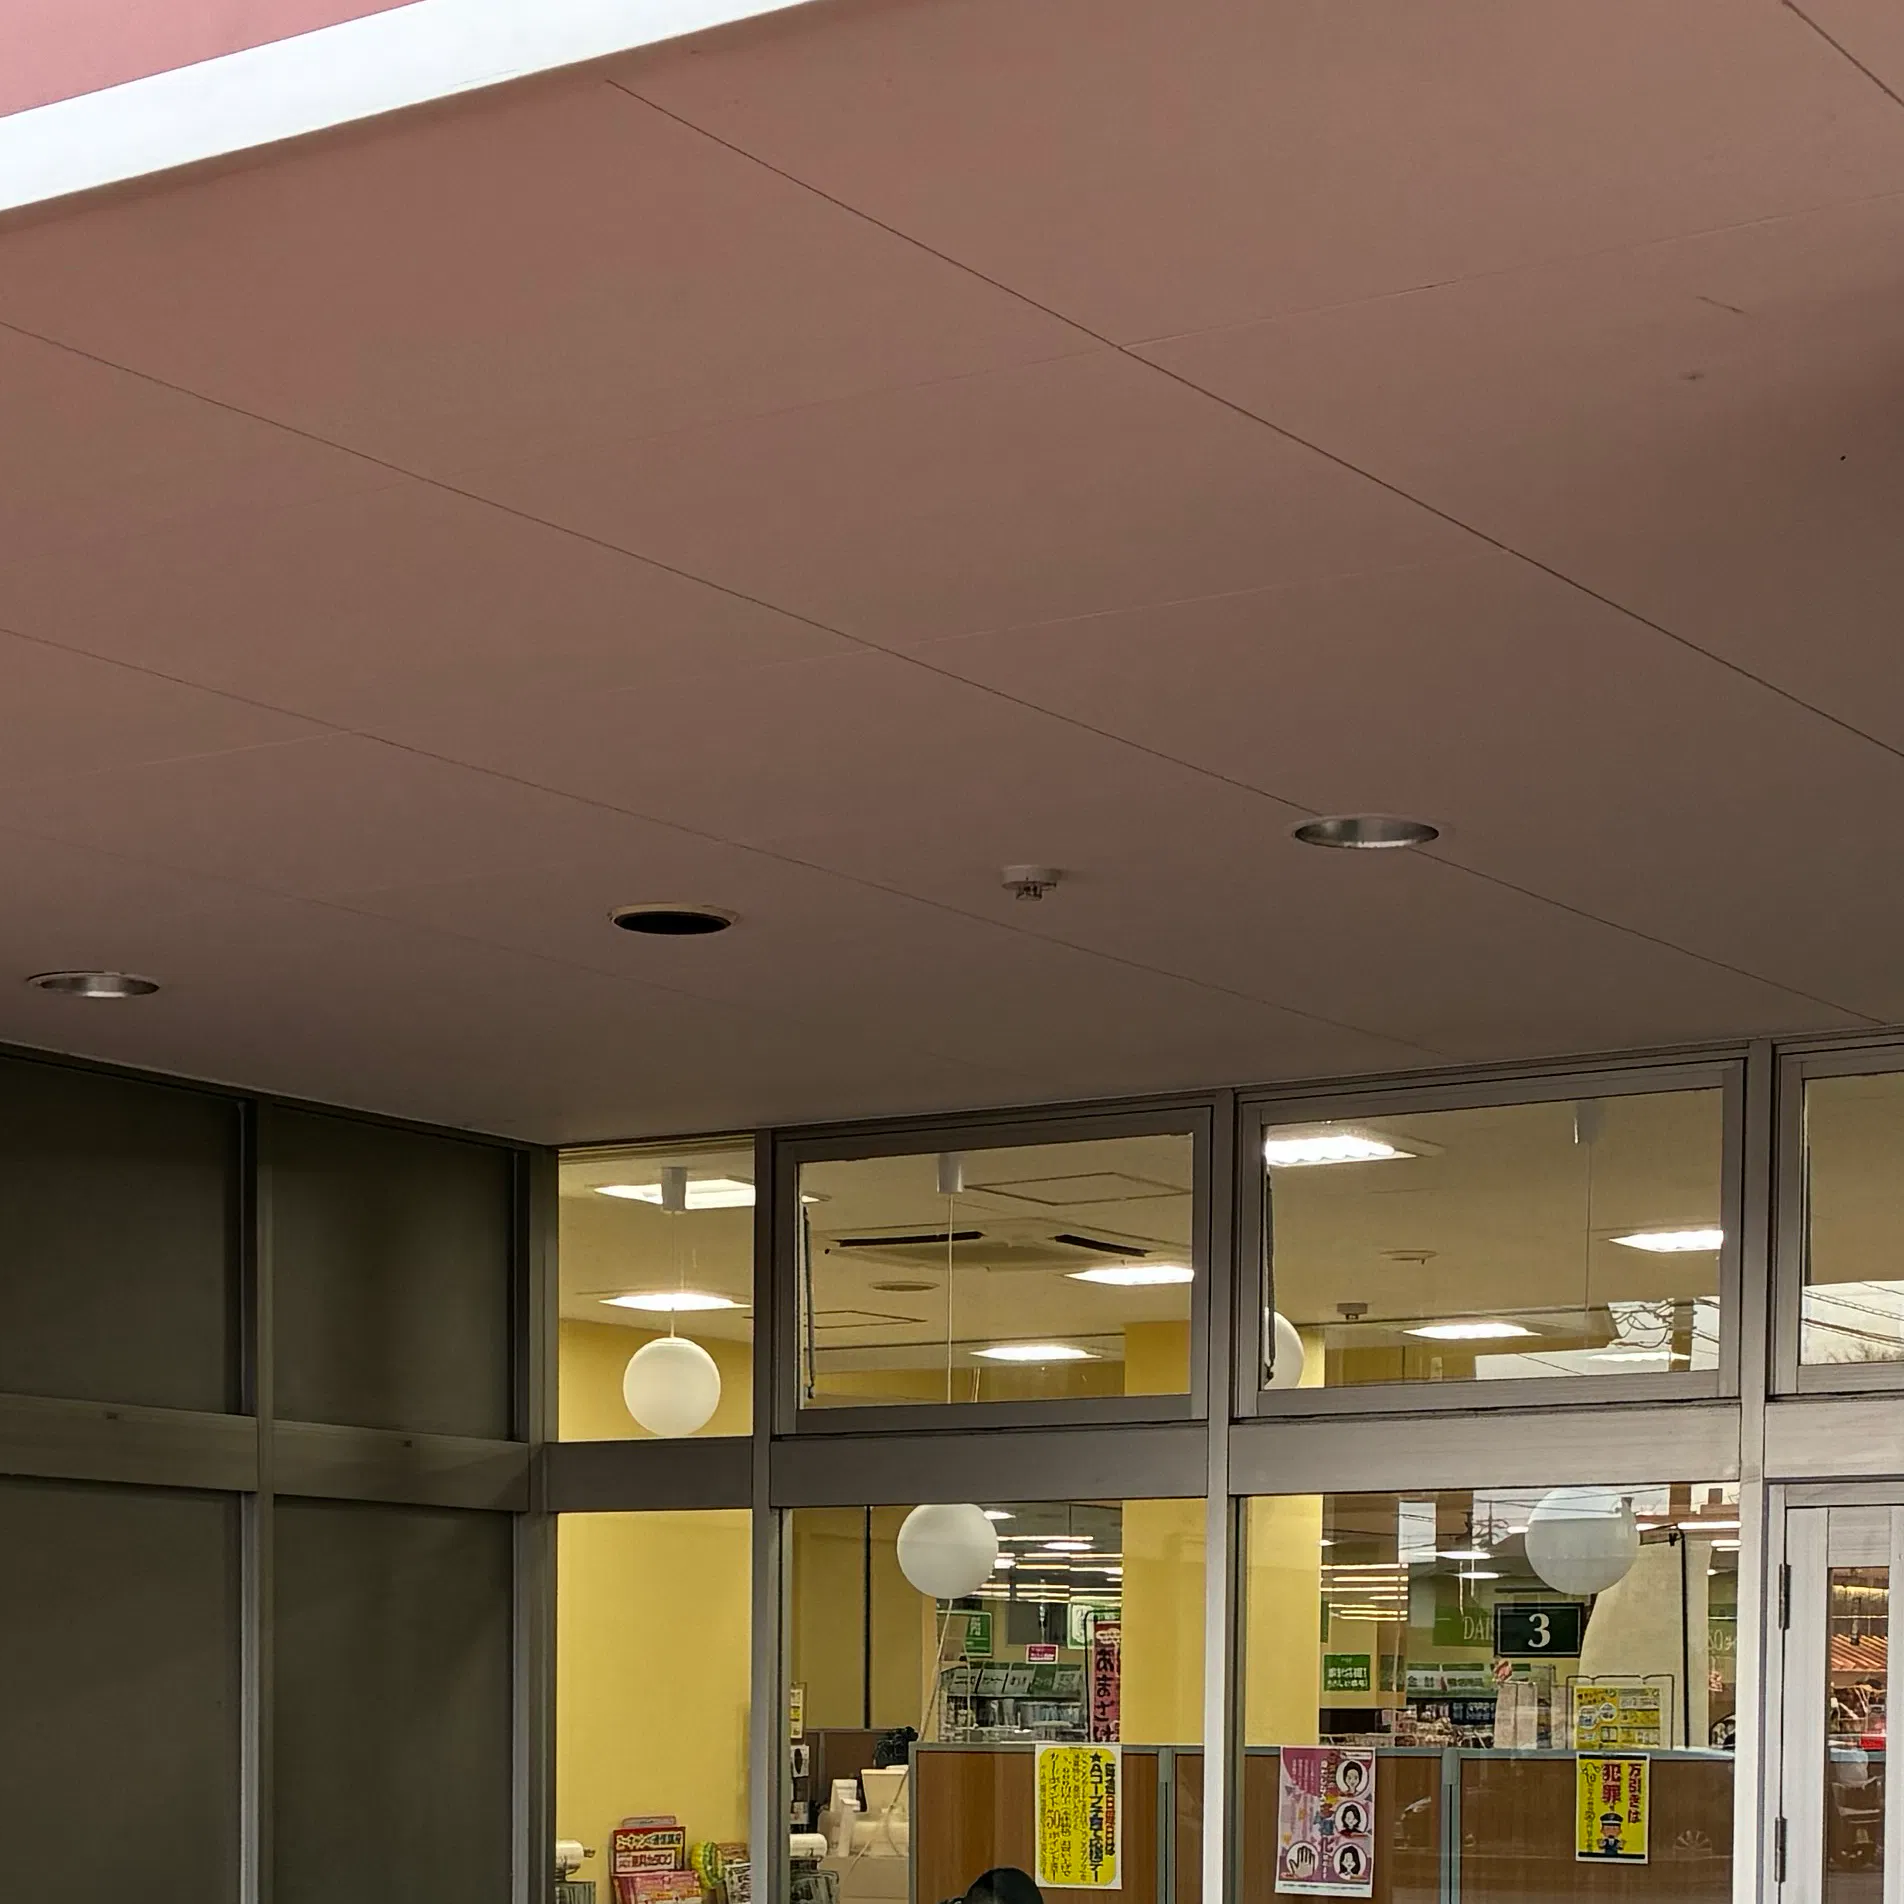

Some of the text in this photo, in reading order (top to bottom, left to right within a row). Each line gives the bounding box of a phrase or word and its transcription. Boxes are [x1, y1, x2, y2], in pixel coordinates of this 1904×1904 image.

[1528, 1613, 1551, 1648] 3
[1628, 1763, 1642, 1823] 万引きは
